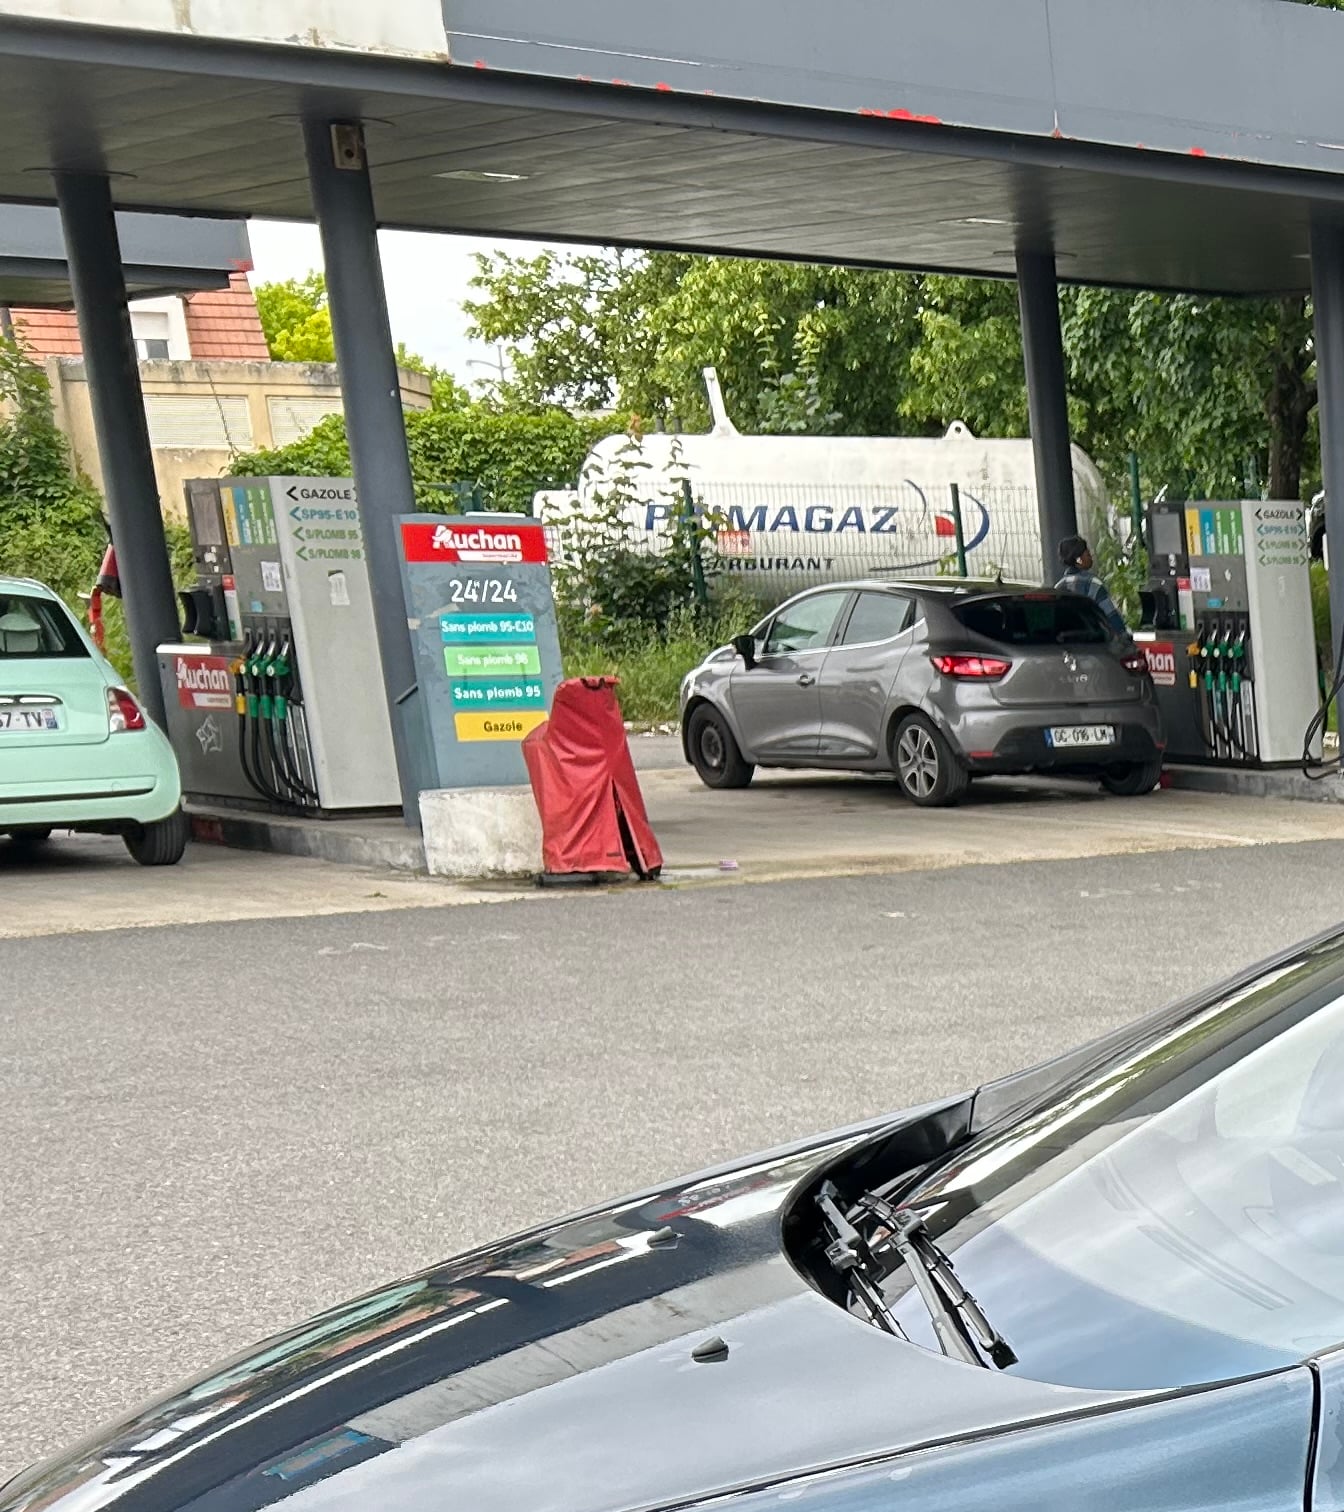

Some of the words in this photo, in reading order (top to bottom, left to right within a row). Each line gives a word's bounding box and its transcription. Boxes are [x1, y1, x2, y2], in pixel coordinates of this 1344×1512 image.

[300, 488, 351, 499] GAZOLE
[301, 508, 357, 520] SP95-E10
[645, 503, 900, 533] PIMAGAZ
[1263, 510, 1295, 519] GAZOLE
[432, 525, 521, 549] Auchan
[441, 620, 465, 633] Sans
[467, 621, 498, 635] plomb
[457, 653, 481, 665] Sans
[483, 653, 513, 668] plomb
[1145, 648, 1174, 671] han
[176, 657, 230, 690] Auchan
[454, 687, 483, 699] Sans
[487, 687, 523, 701] plomb
[525, 685, 541, 697] 95
[0, 712, 42, 728] 7-TV
[483, 720, 523, 732] Gazole
